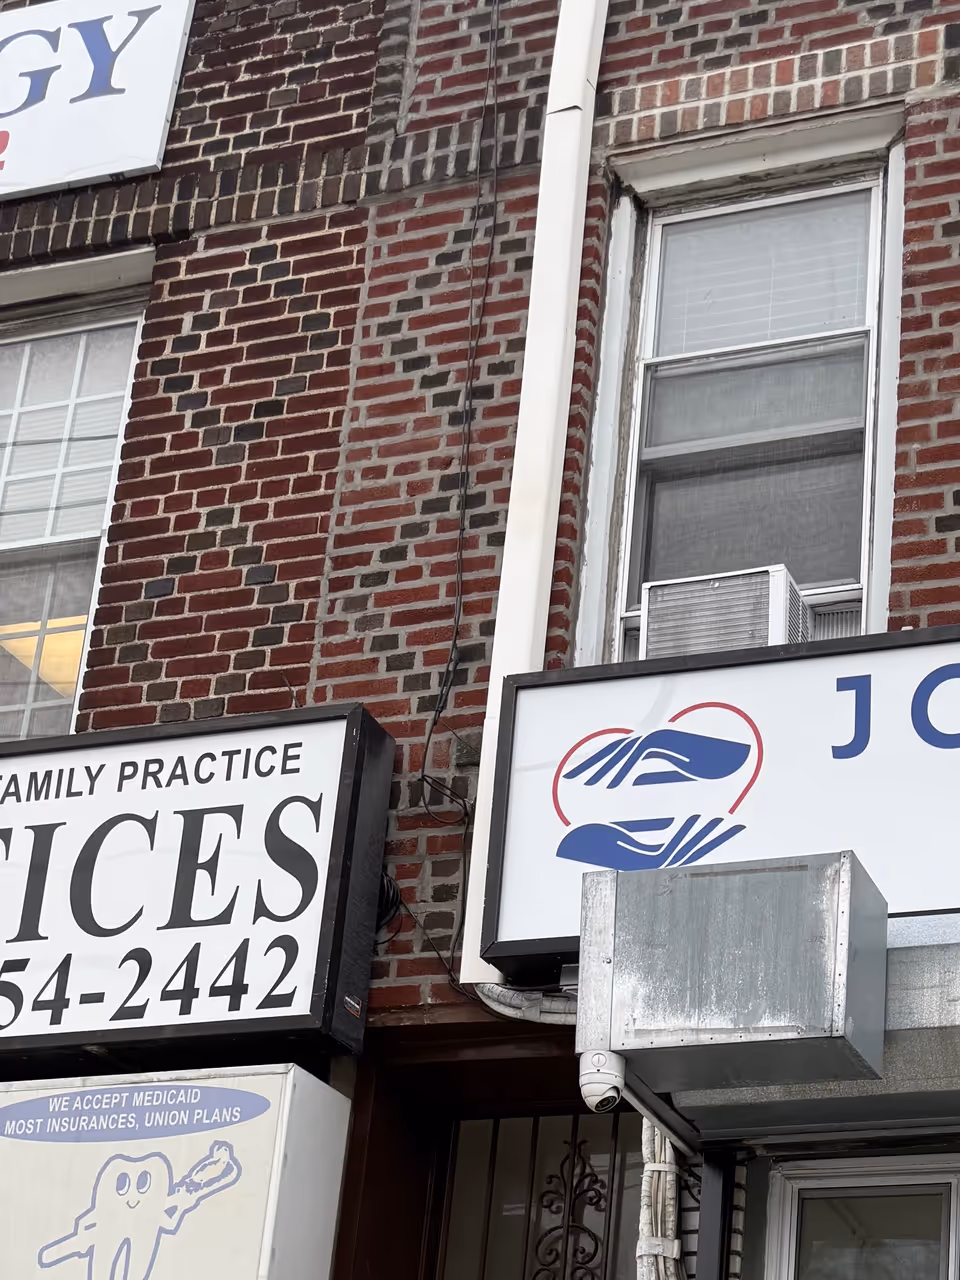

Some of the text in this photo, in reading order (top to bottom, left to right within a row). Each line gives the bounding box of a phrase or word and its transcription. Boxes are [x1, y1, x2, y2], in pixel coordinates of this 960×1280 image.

[0, 742, 303, 804] AMILY PRACTICE
[0, 792, 323, 943] ICES
[4, 1106, 241, 1135] MOST INSURANCES, UNION PLANS
[49, 1088, 201, 1112] WE ACCEPT MEDICAID
